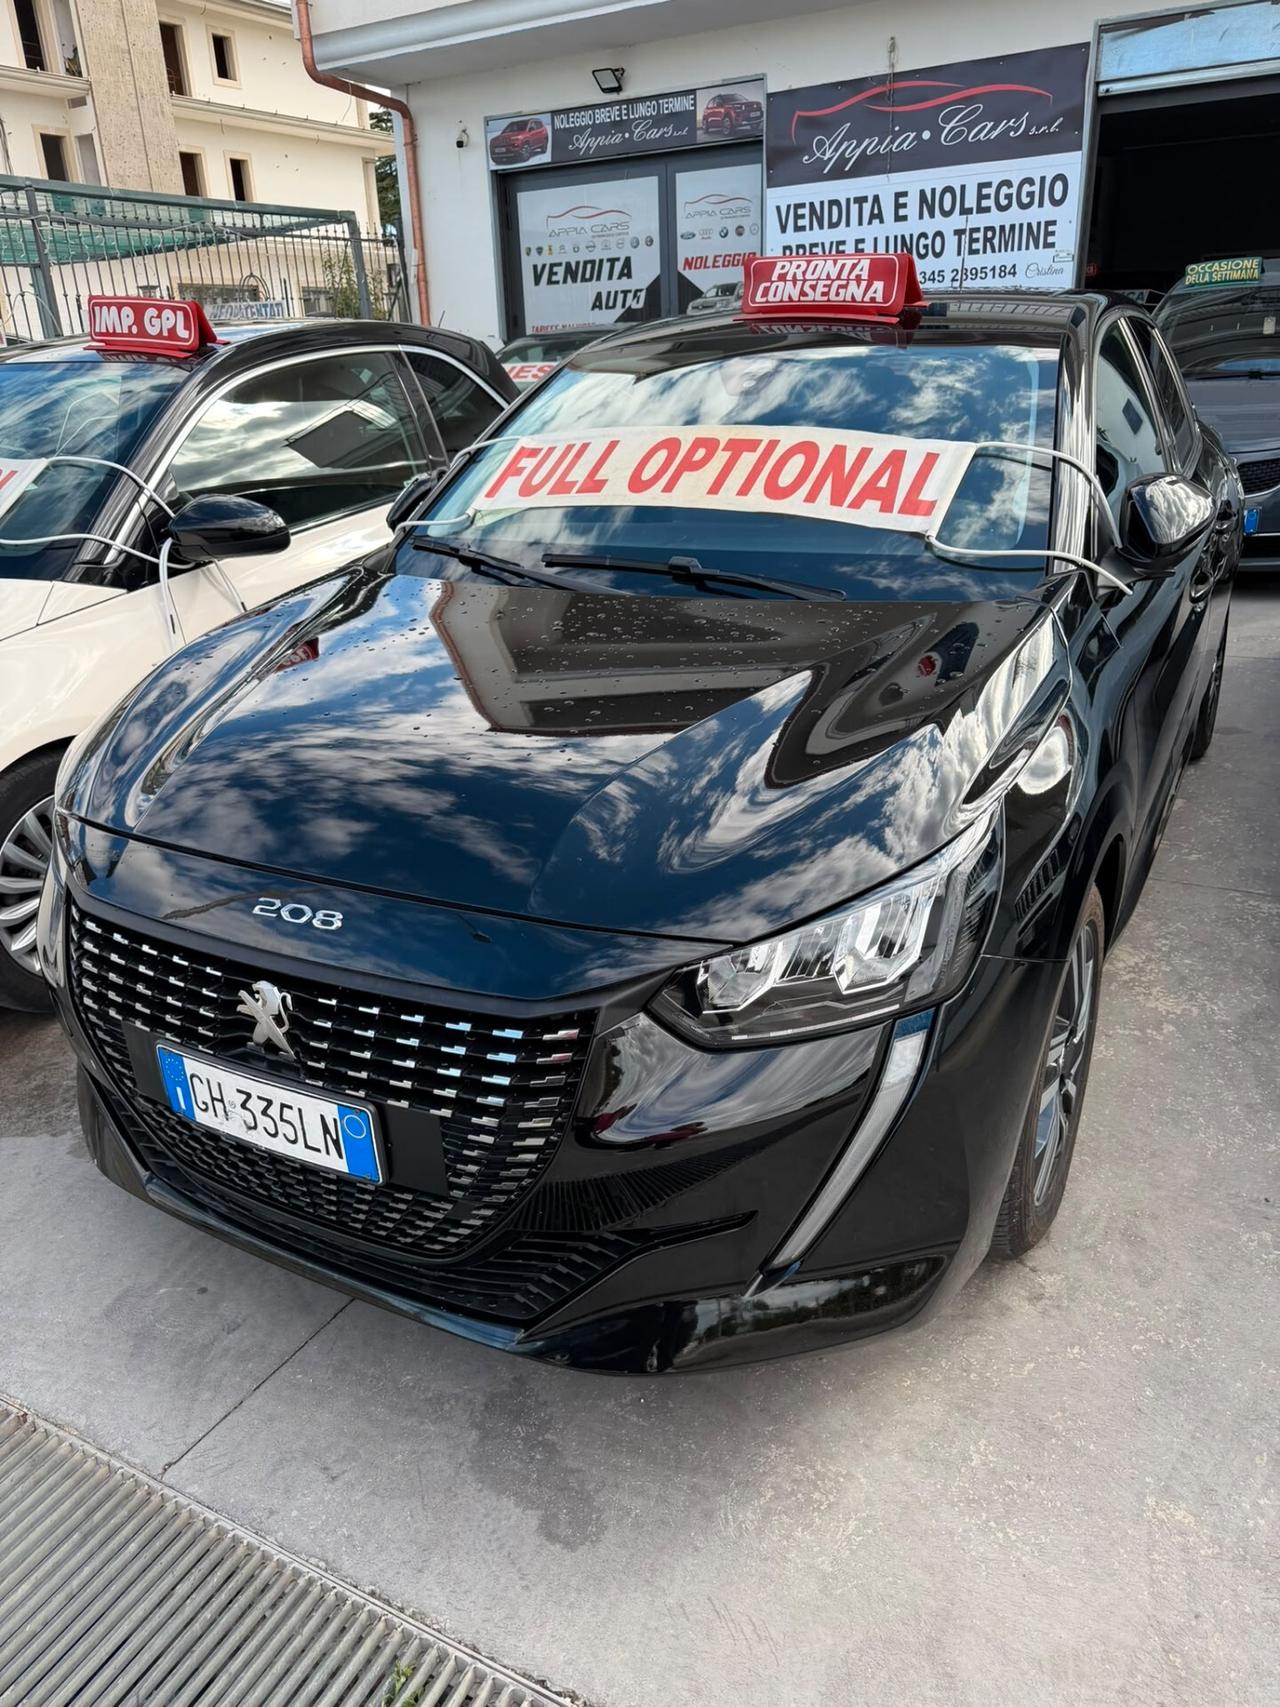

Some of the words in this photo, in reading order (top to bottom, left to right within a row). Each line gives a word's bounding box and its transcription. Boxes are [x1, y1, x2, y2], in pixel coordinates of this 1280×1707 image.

[554, 111, 594, 129] NOLEGGIO
[594, 105, 621, 124] BREVE
[621, 104, 628, 120] E
[629, 100, 658, 118] LUNGO
[659, 95, 695, 114] TERMINE
[568, 128, 624, 156] Appia
[631, 119, 673, 142] Cars
[802, 122, 921, 174] Appia
[938, 103, 1029, 146] Cars
[685, 209, 718, 219] APPIA
[719, 206, 752, 216] CARS
[776, 193, 886, 234] VENDITA
[893, 191, 909, 222] E
[918, 172, 1069, 220] NOLEGGIO
[548, 226, 588, 238] APPIA
[590, 220, 631, 234] CARS
[953, 219, 1058, 257] TERMINE
[532, 256, 632, 286] VENDITA
[771, 259, 871, 281] PRONTA
[919, 270, 945, 285] 345
[1185, 273, 1209, 285] DELLA
[1212, 268, 1259, 282] SETTIMANA
[1187, 258, 1259, 275] OCCASIONE
[591, 288, 646, 311] AUTO
[755, 280, 885, 303] CONSEGNA
[94, 305, 138, 334] IMP.
[144, 307, 190, 339] GPL
[484, 439, 620, 499] FULL
[627, 436, 941, 517] OPTIONAL
[252, 897, 343, 931] 208
